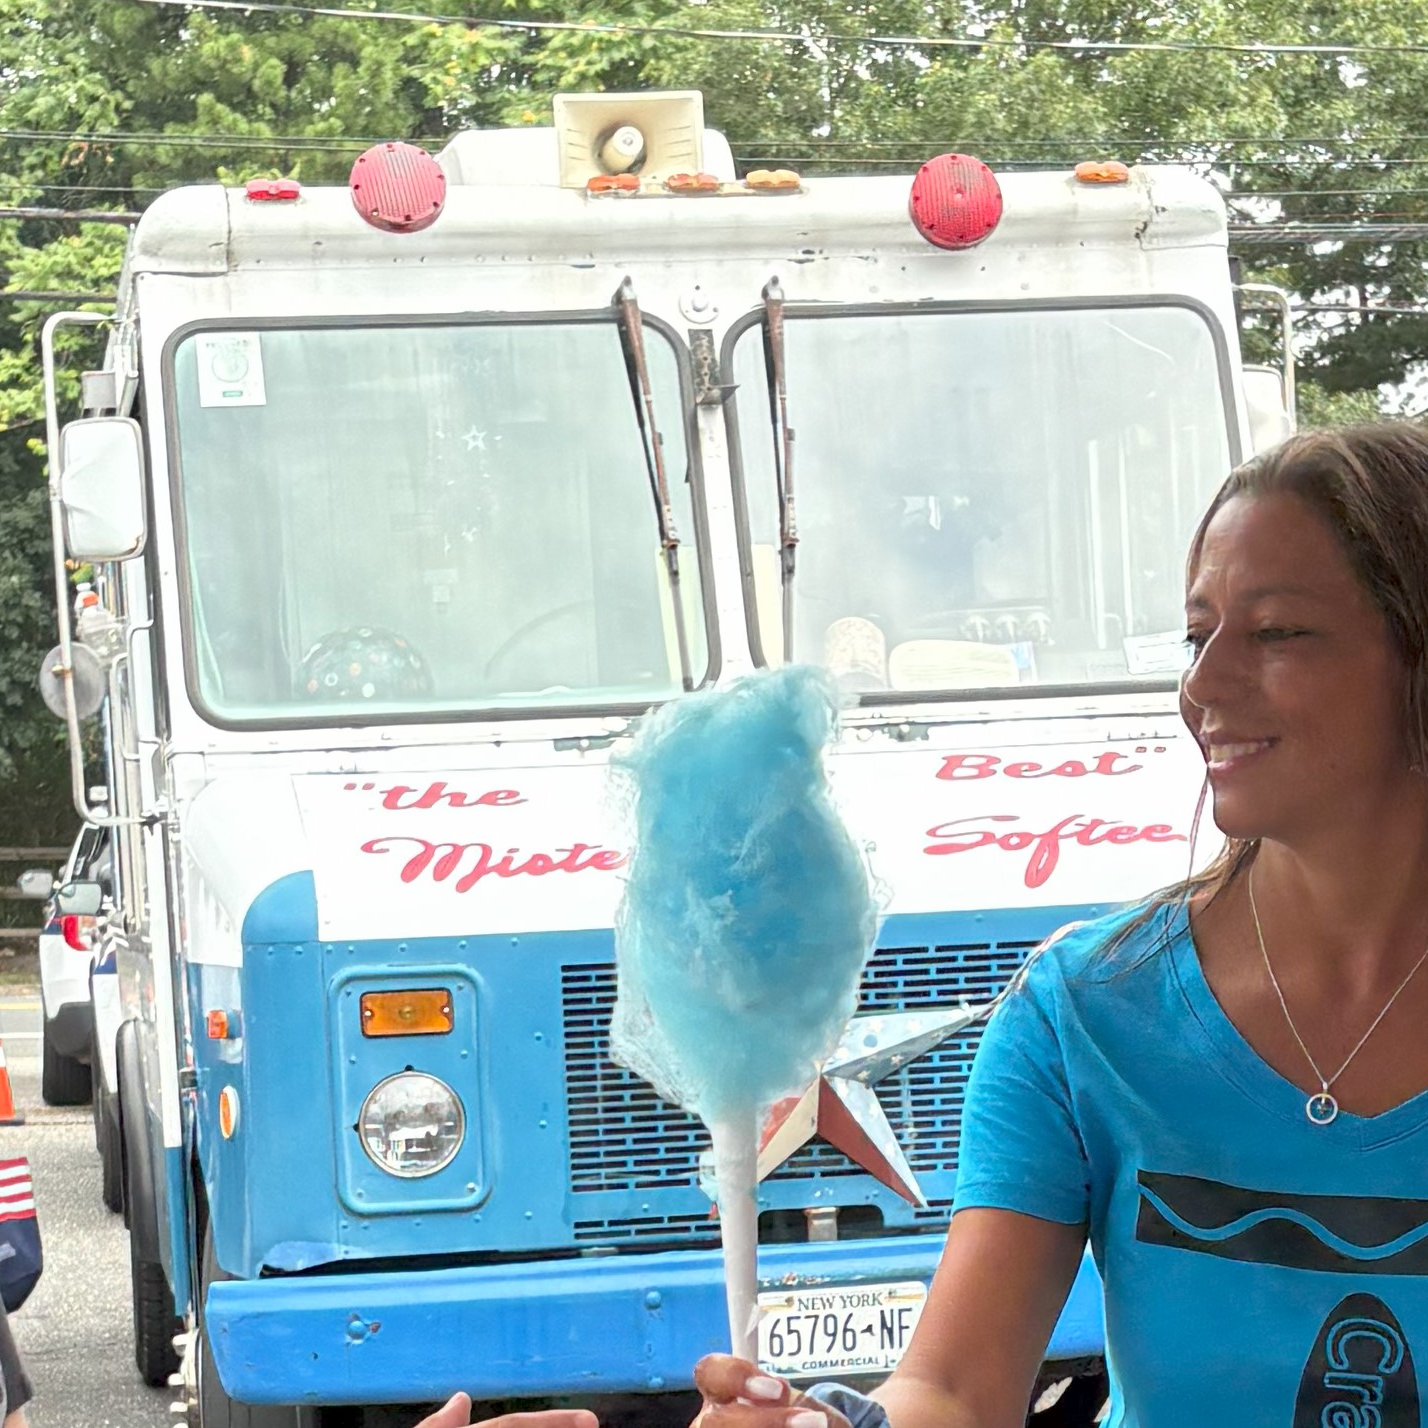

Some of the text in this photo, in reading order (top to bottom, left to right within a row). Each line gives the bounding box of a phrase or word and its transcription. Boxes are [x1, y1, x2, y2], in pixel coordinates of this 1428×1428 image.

[360, 814, 1188, 893] Miste Softee
[797, 1292, 884, 1312] NEW YORK
[769, 1312, 857, 1357] 65796
[802, 1358, 880, 1371] COMMERCIAL
